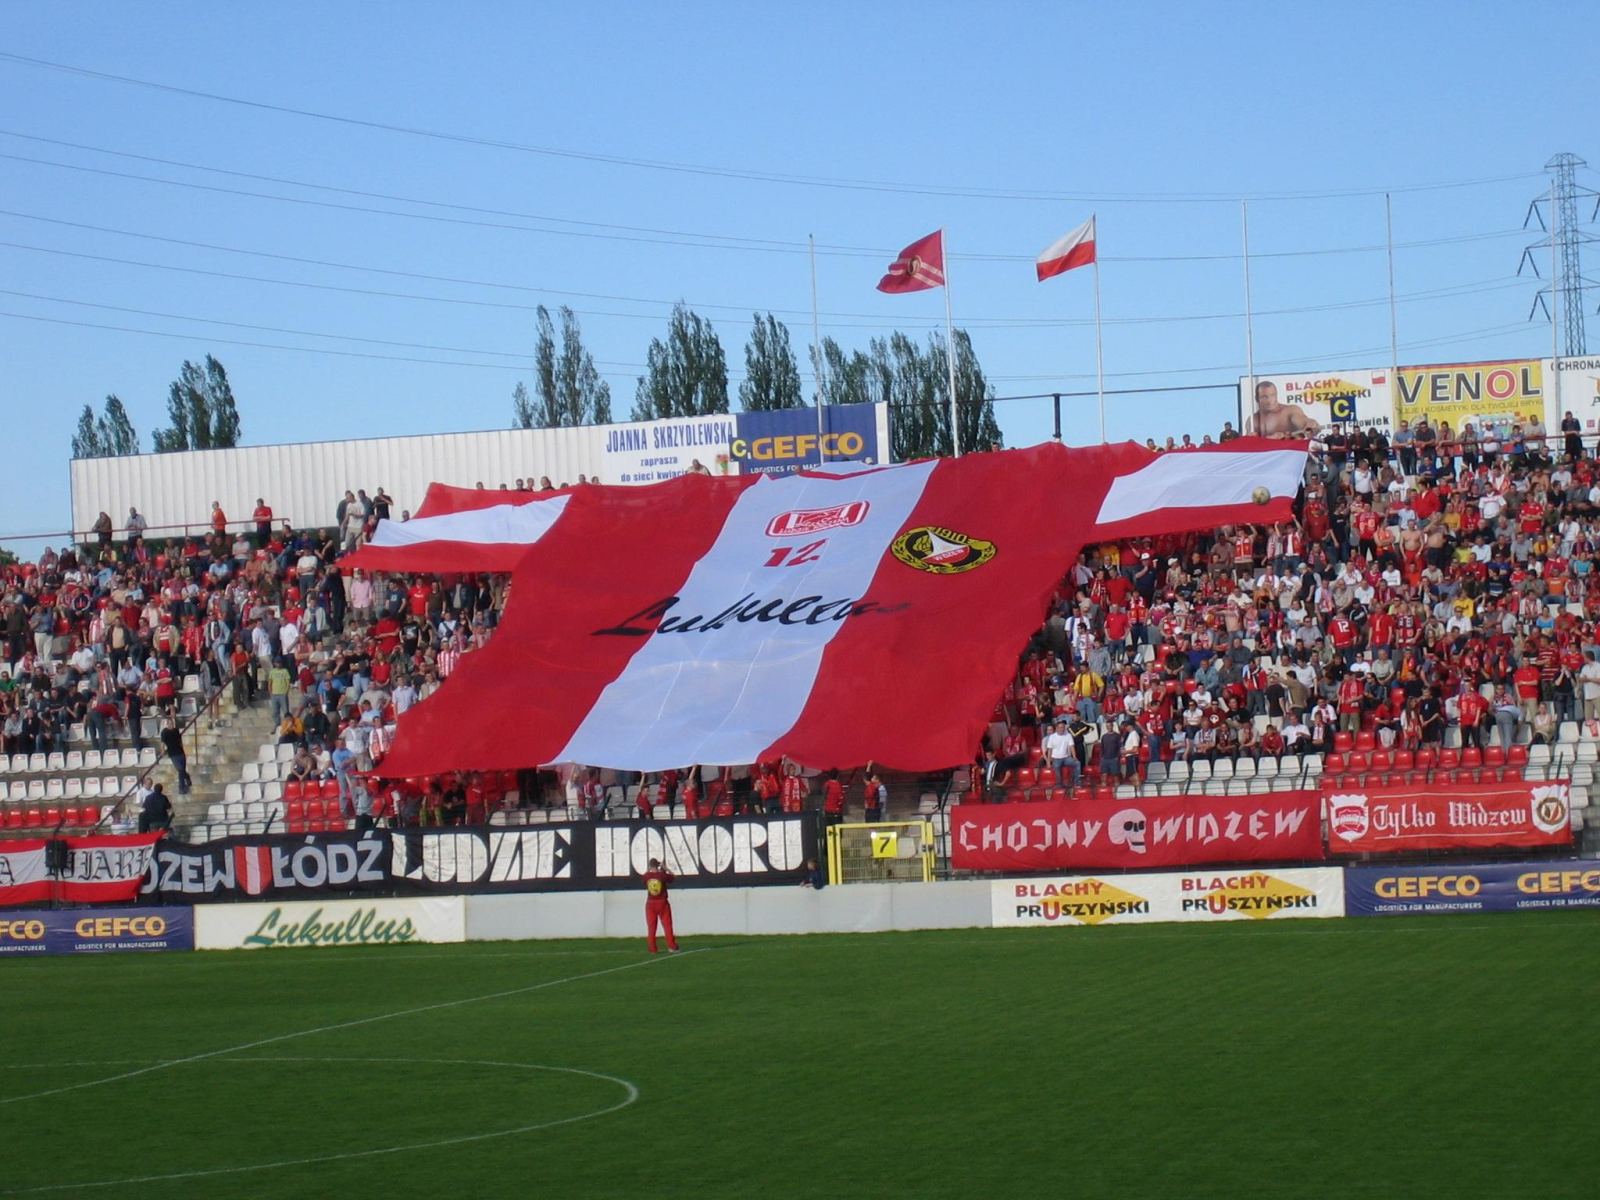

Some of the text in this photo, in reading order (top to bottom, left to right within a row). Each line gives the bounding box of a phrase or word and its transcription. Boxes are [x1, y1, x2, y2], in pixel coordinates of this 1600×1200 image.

[1285, 379, 1340, 391] BLACHY
[1396, 367, 1541, 403] VENOL
[1333, 399, 1350, 418] C
[606, 421, 733, 453] JOANNA SKRZYDLEWSKA
[752, 432, 863, 460] GEFCO
[640, 456, 678, 467] zaprasza
[787, 464, 799, 472] FO
[620, 472, 631, 482] do
[633, 469, 654, 481] sieci
[934, 526, 968, 543] 1910
[763, 538, 828, 567] 12
[1337, 620, 1350, 633] 12
[959, 807, 1310, 852] CHOJNY WIDZEW
[1372, 801, 1527, 838] Tylko Widzew
[595, 820, 803, 877] HONORU
[879, 836, 891, 853] 7
[271, 830, 384, 888] ŁÓDŹ
[391, 828, 571, 883] LUDZIE
[1015, 881, 1104, 897] BLACHY
[1181, 875, 1270, 891] BLACHY
[1374, 875, 1480, 898] GEFCO
[1016, 899, 1149, 920] PRUSZYŃSKI
[1182, 893, 1317, 914] PRUSZYŃSKI
[1374, 902, 1482, 912] LOGISTICS FOR MANUFACTURERS
[1516, 900, 1550, 908] LOGISTICS
[75, 916, 166, 938] GEFCO
[243, 907, 416, 946] Lukullus
[118, 941, 168, 949] MANUFACTURERS
